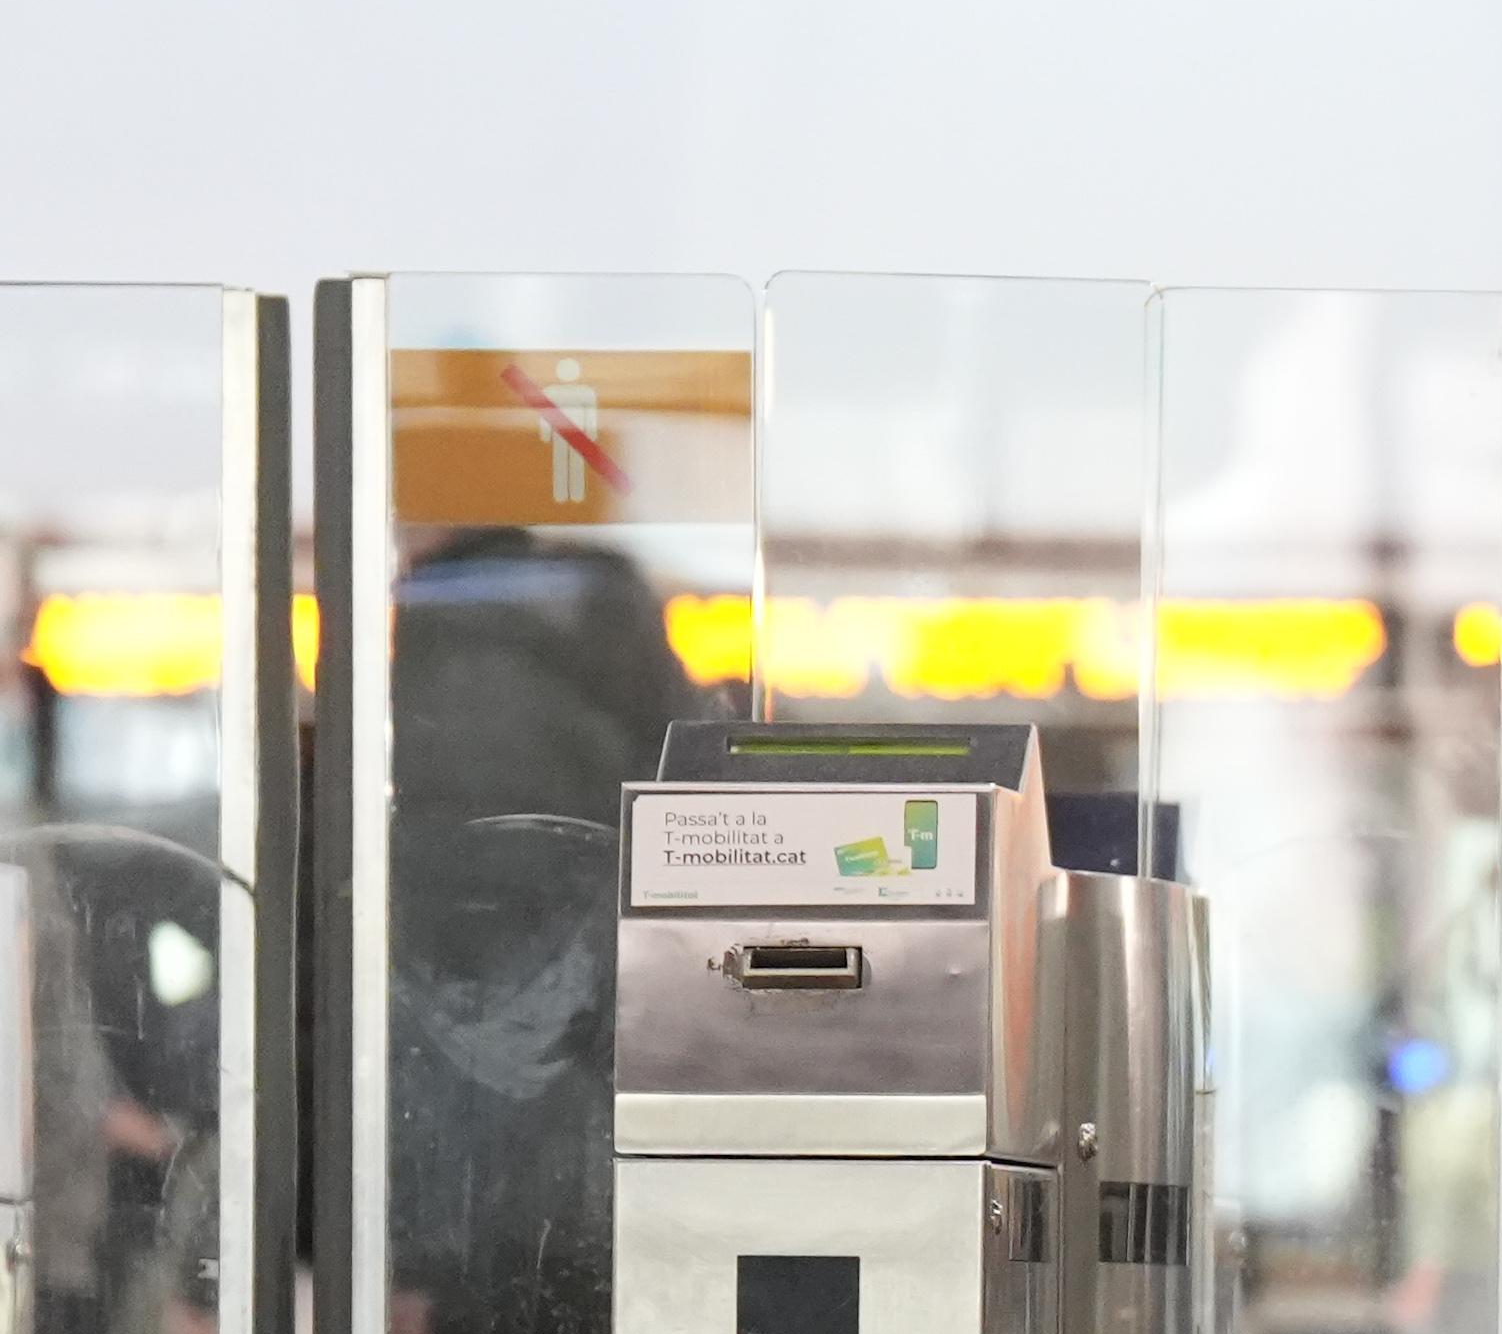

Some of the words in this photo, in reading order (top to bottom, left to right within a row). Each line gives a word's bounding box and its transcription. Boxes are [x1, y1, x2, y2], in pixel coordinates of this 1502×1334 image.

[665, 811, 729, 826] Passa't
[735, 814, 745, 826] a
[752, 811, 767, 826] la
[664, 830, 769, 845] T-mobilitat
[774, 833, 784, 845] a
[663, 849, 807, 865] T-mobilitat.cat
